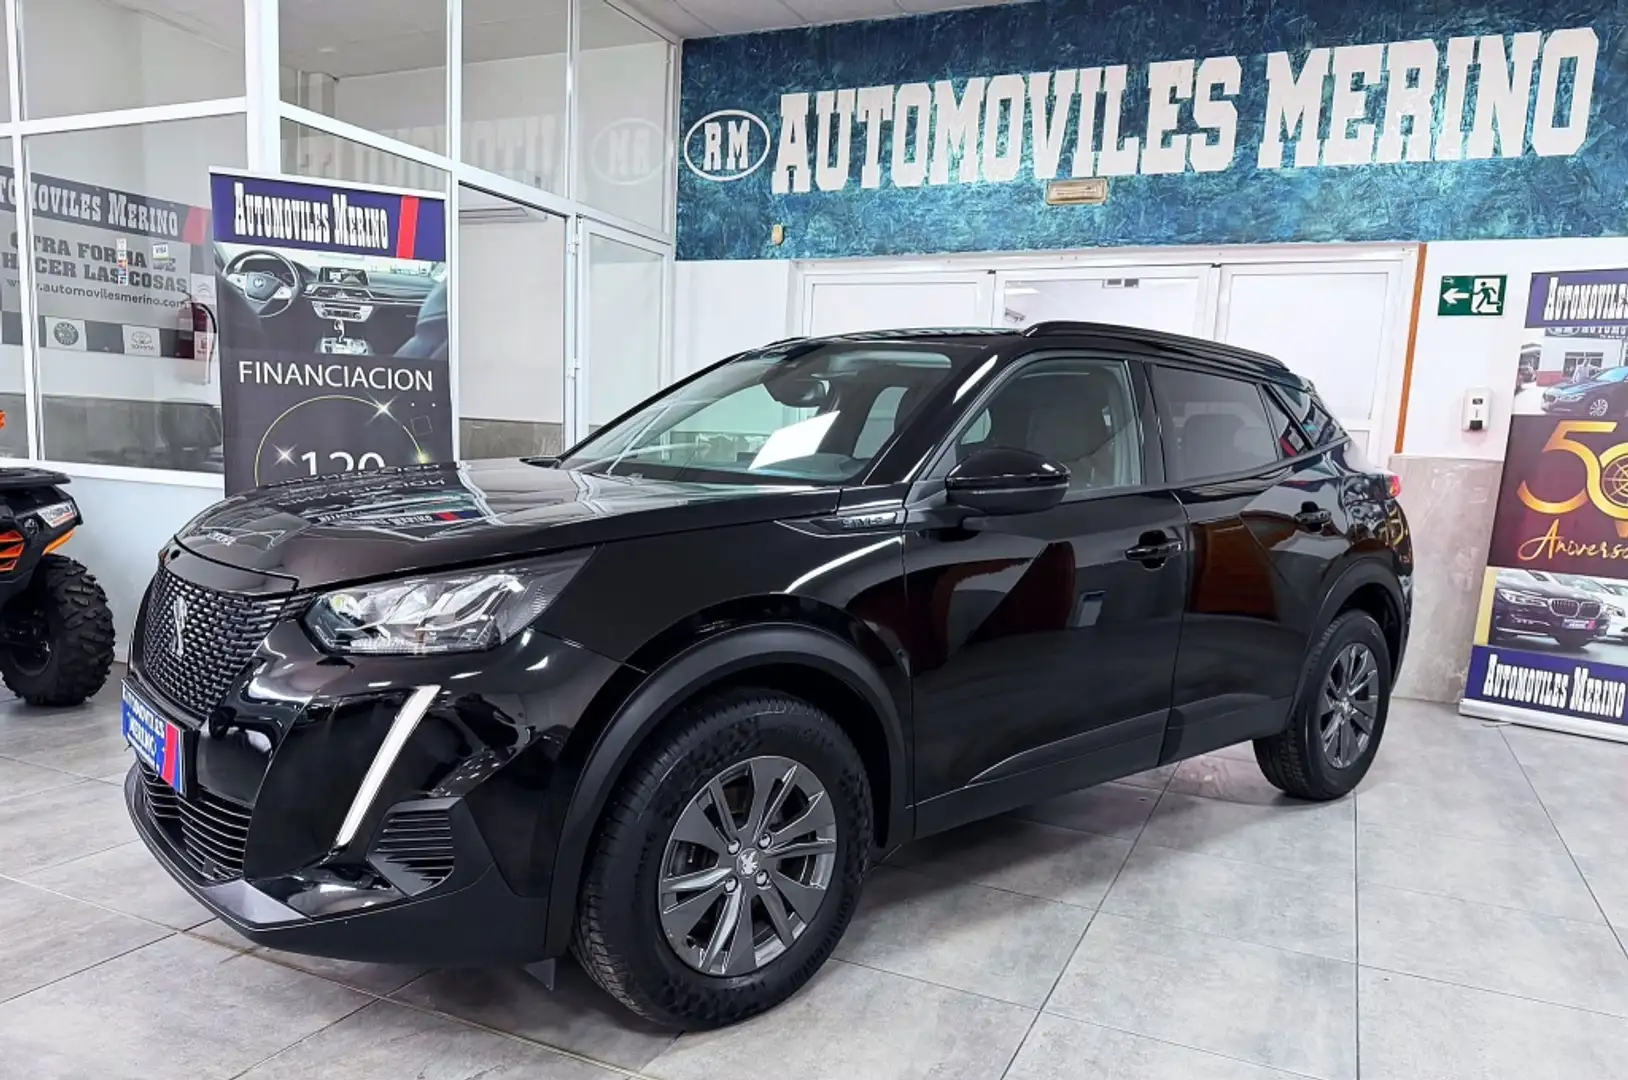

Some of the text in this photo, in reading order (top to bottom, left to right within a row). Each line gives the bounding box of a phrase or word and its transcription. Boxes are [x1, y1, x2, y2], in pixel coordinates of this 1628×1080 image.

[772, 27, 1599, 194] AUTOMOVILES MERINO
[703, 119, 750, 171] RM
[108, 192, 178, 236] MERINO
[234, 182, 389, 249] AUTOMOVILES MERINO
[2, 252, 77, 278] HCER
[129, 270, 187, 293] COSAS
[6, 278, 188, 309] w.automovilesmerino.com
[1543, 276, 1628, 321] AUTOMOVILE
[239, 360, 433, 392] FINANCIACION
[1482, 653, 1627, 718] AUTOMOVILES MERINO
